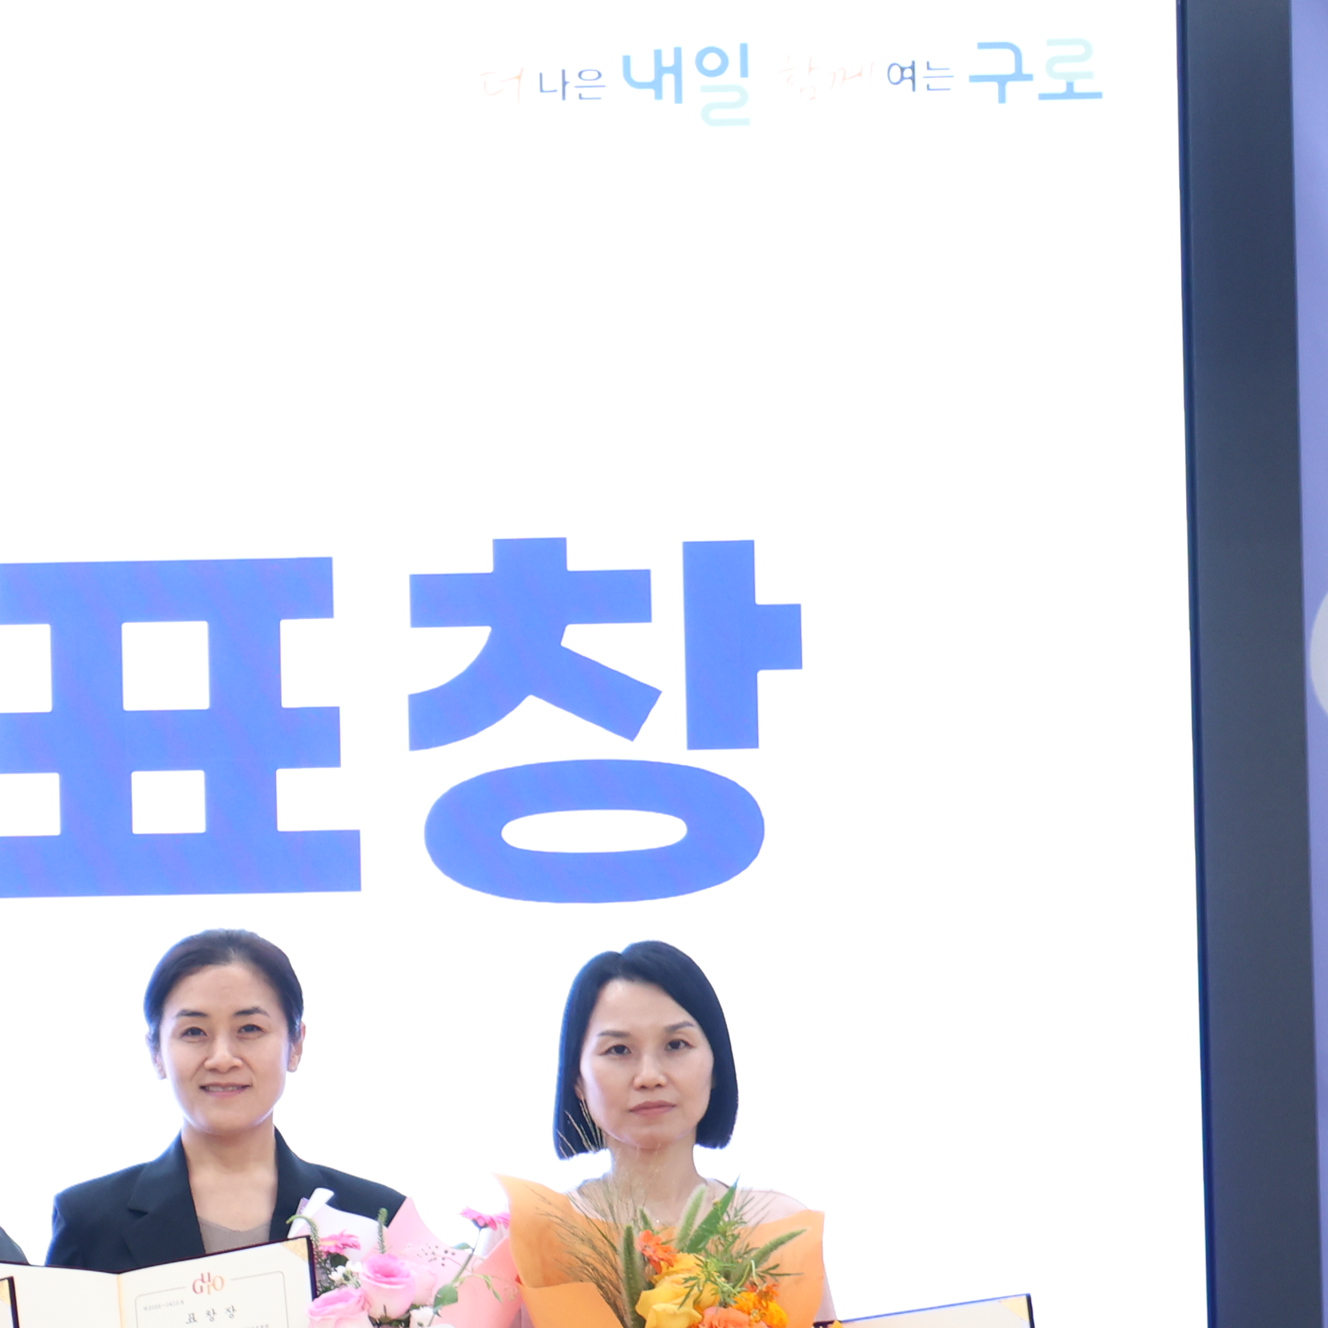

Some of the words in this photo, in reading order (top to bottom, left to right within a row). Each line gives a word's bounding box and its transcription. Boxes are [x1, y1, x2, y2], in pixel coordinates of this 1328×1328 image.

[539, 67, 606, 100] 나은
[622, 42, 750, 127] 내일
[887, 59, 954, 92] 여는
[969, 38, 1103, 104] 구로
